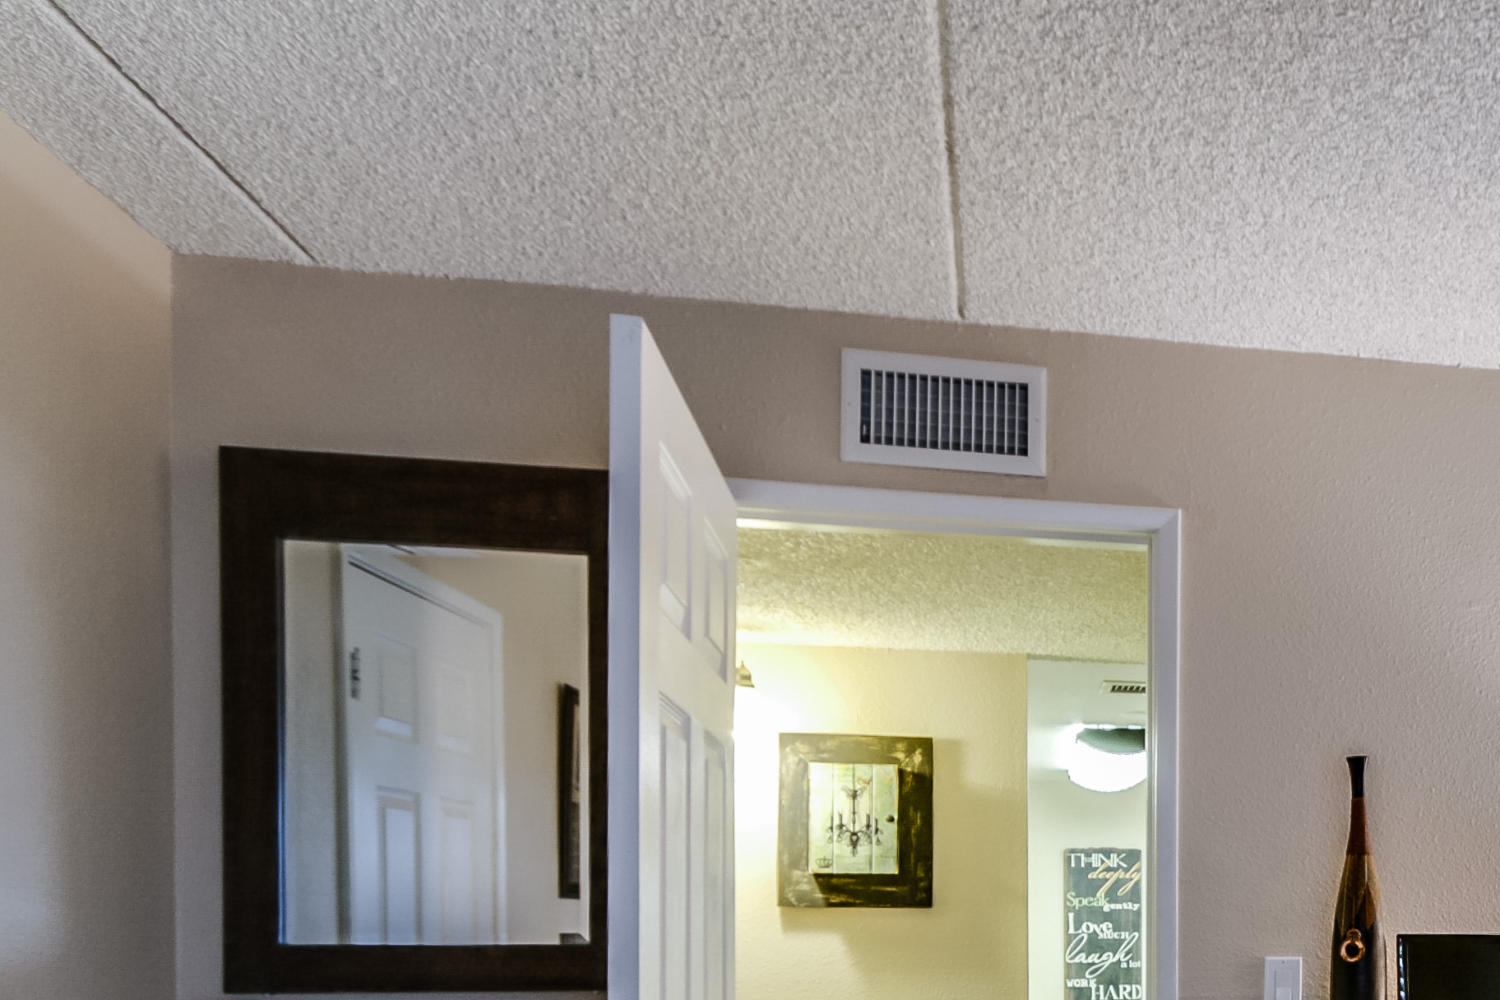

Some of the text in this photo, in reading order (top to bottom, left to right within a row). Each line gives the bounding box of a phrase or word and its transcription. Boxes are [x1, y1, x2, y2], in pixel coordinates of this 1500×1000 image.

[1068, 853, 1127, 868] THINK
[1087, 860, 1142, 897] deeply
[1066, 892, 1110, 910] Speak
[1103, 902, 1140, 912] gently
[1068, 912, 1112, 936] Love
[1065, 932, 1139, 979] laugh
[1090, 984, 1142, 1000] HARD
